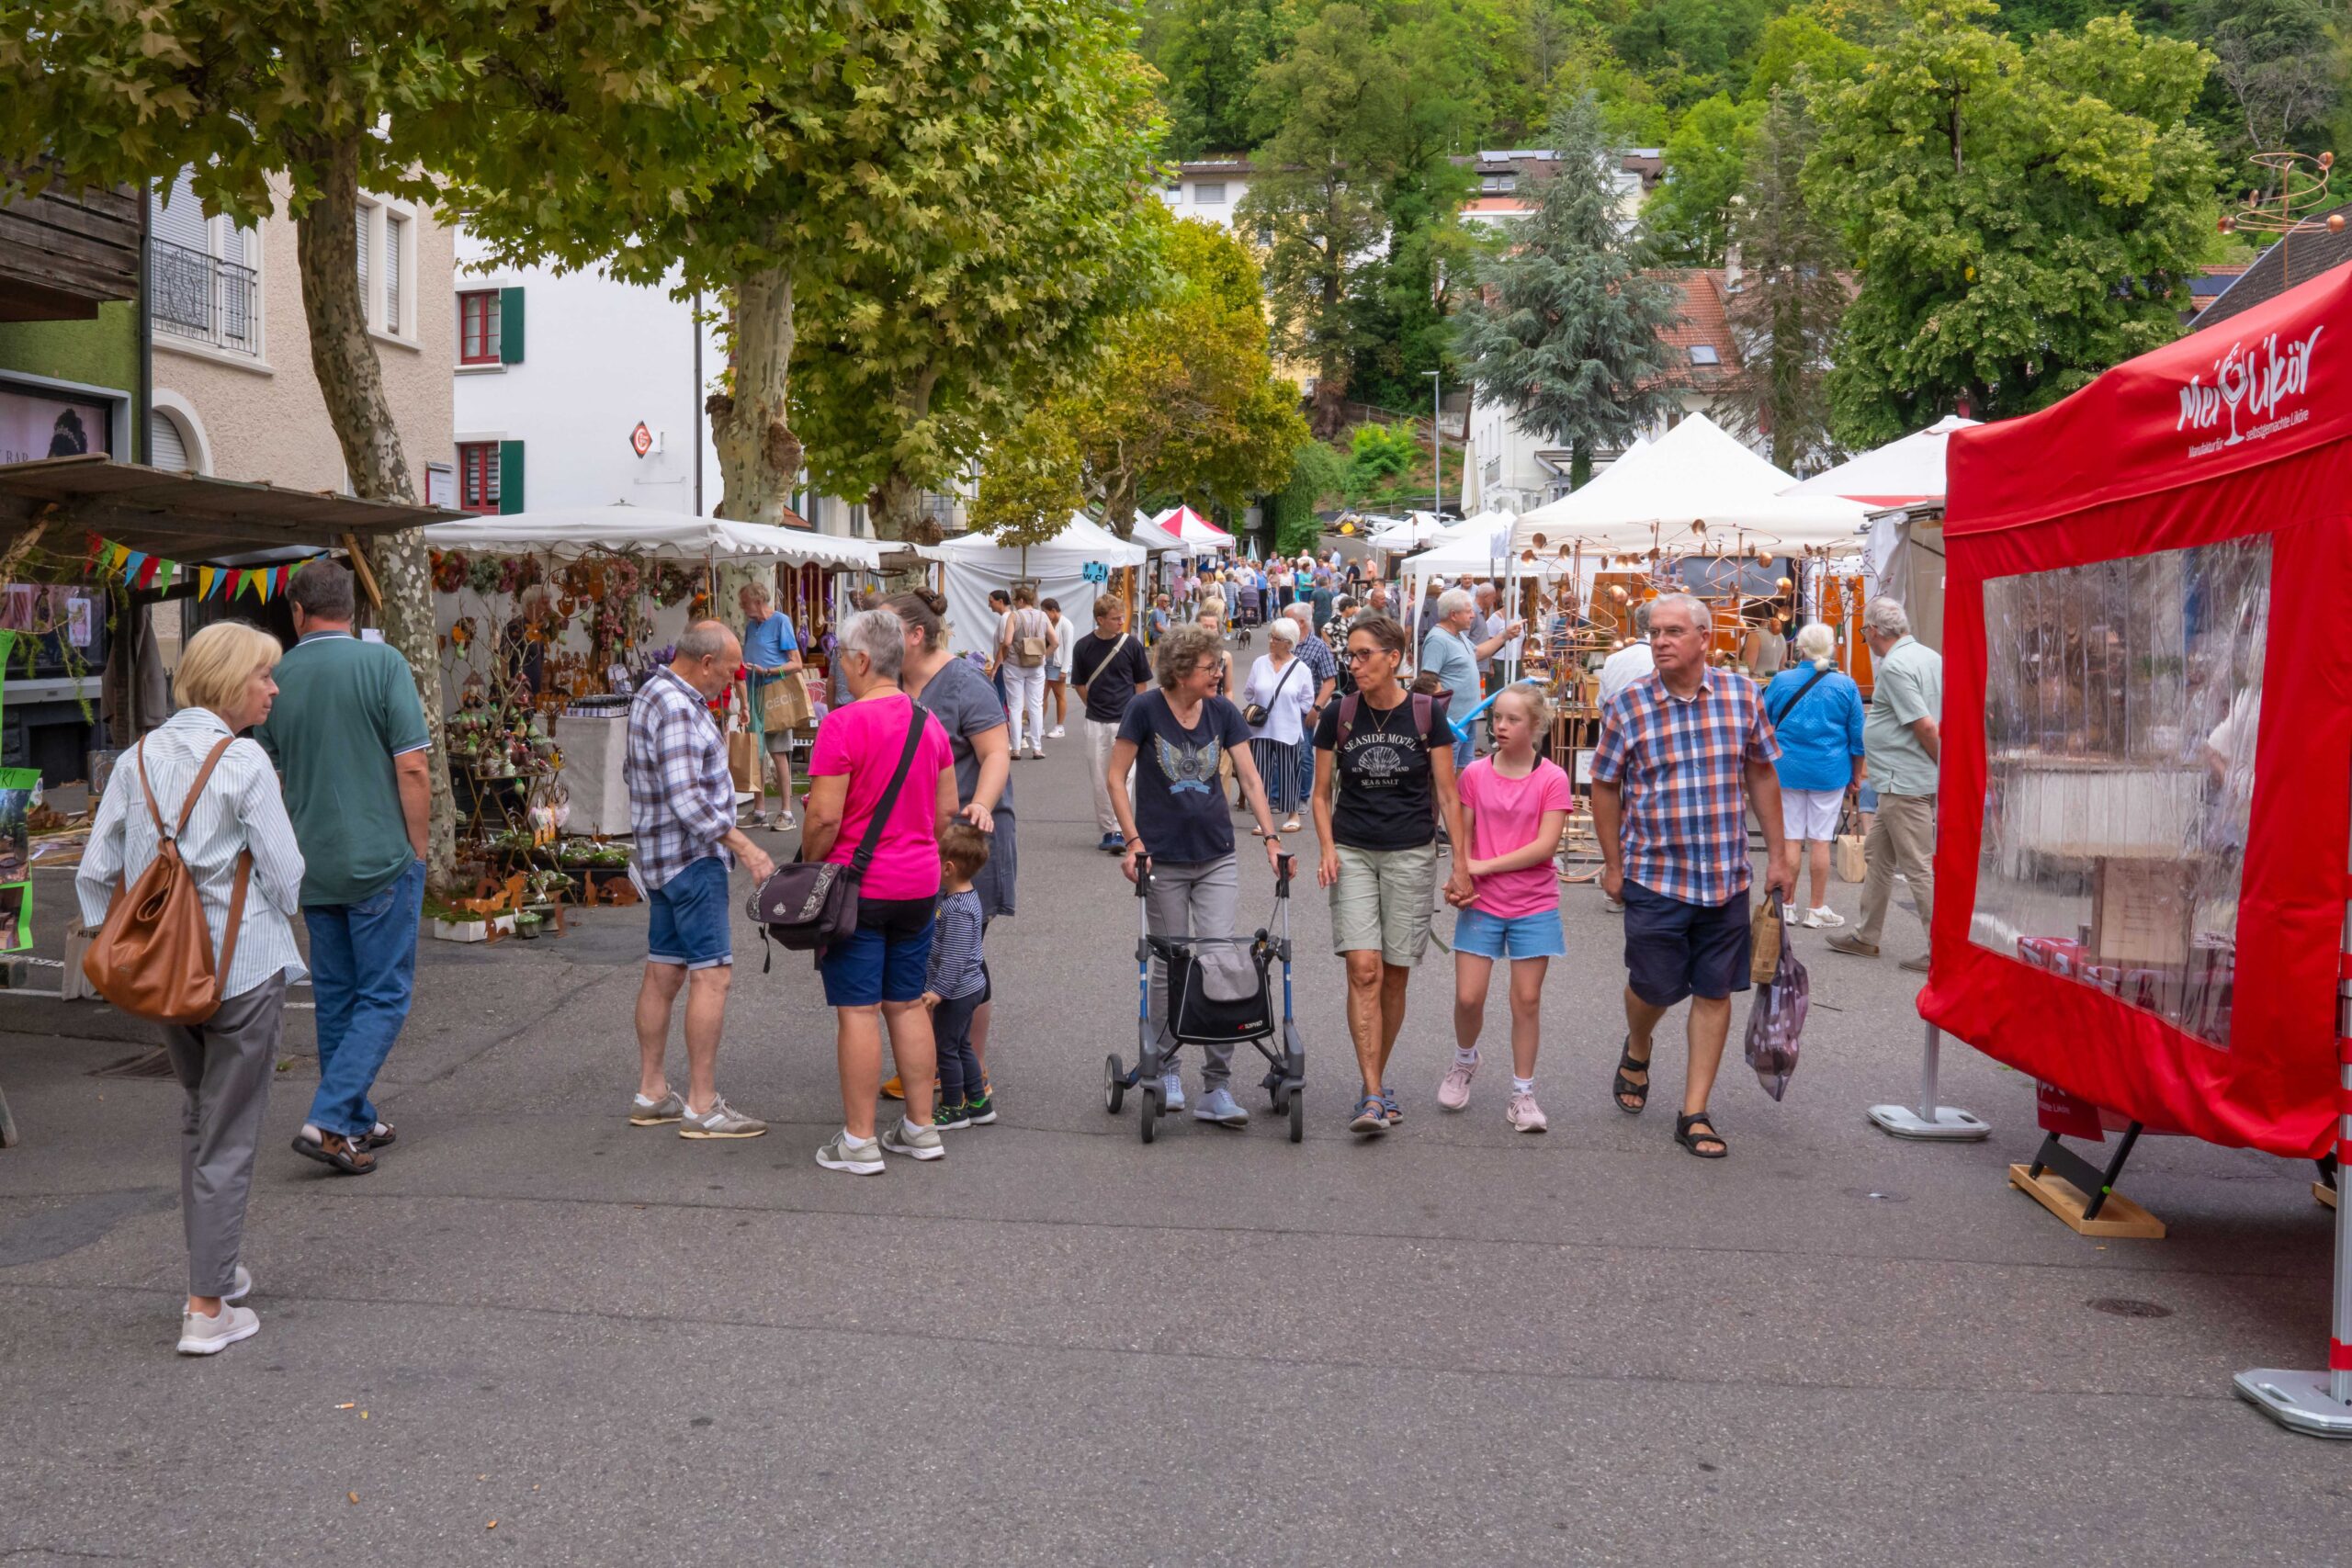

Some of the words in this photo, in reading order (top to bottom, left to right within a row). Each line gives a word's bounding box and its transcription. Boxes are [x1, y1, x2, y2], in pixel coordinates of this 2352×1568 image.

[2247, 325, 2324, 420] Likör
[2245, 415, 2290, 441] selbstgemachte
[2290, 409, 2309, 426] Liköre
[765, 692, 798, 710] CECIL
[1344, 733, 1385, 752] SEASIDE
[0, 769, 16, 787] KI
